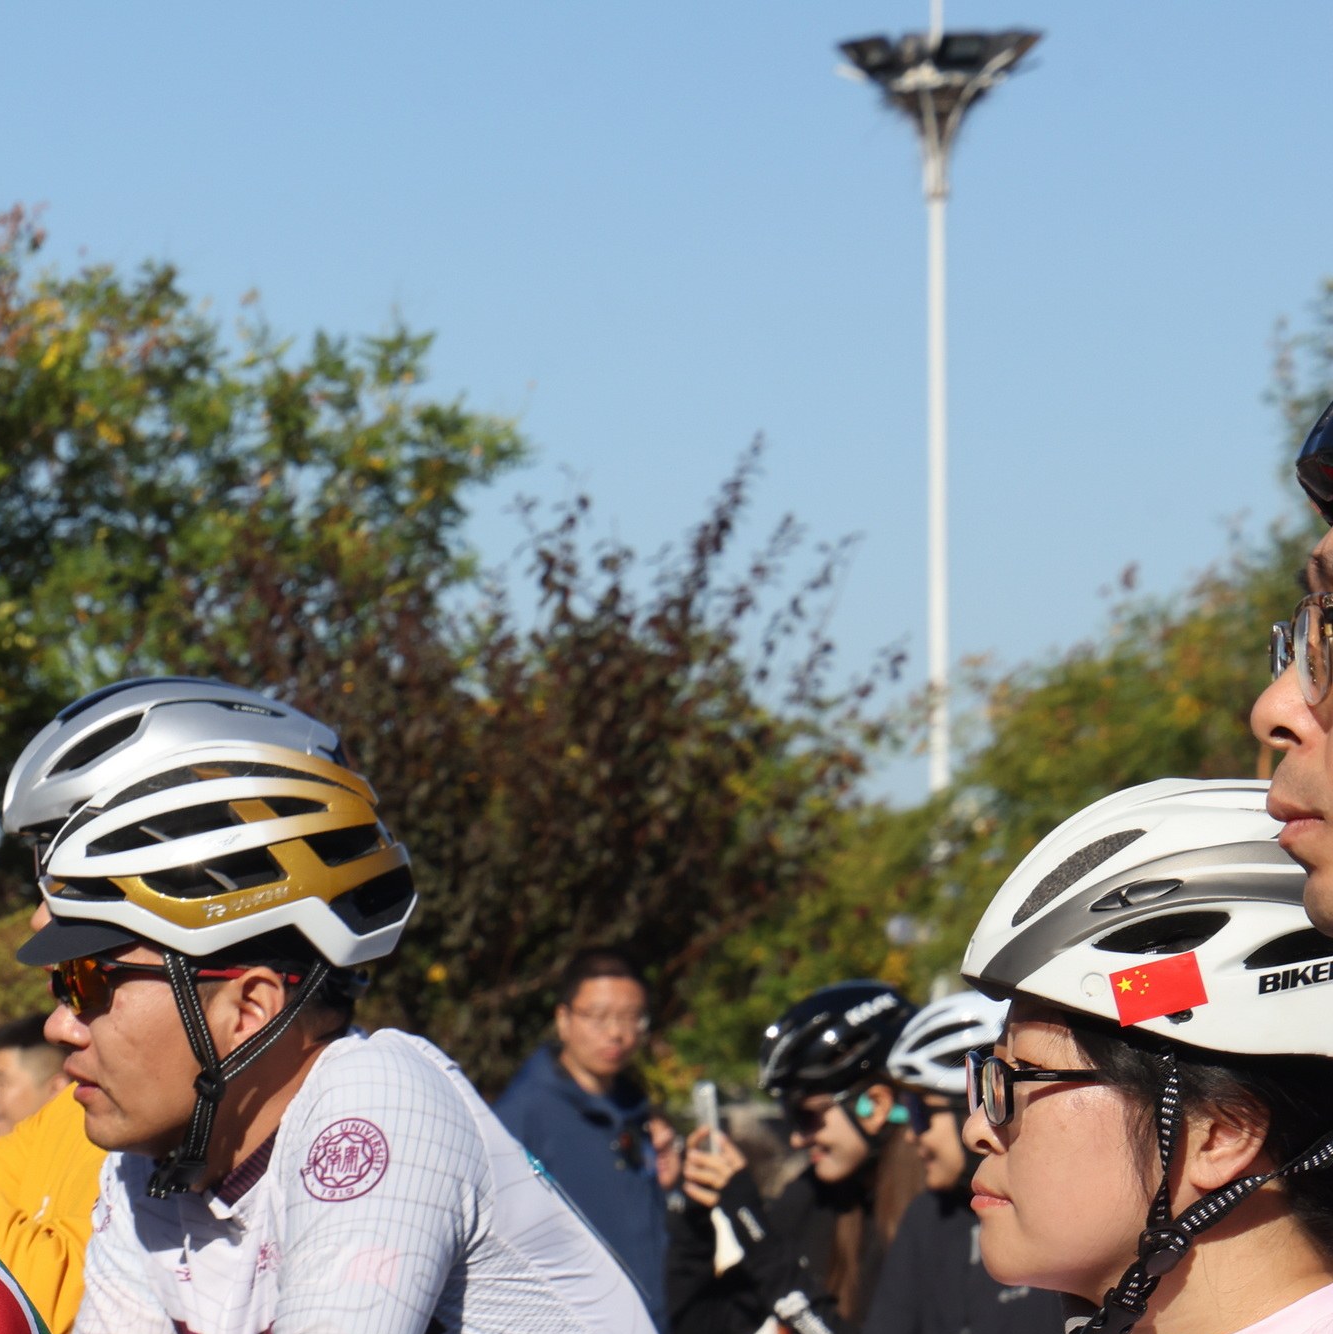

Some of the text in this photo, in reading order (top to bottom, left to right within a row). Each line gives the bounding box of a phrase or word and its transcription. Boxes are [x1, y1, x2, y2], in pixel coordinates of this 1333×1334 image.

[1258, 960, 1333, 995] BIKE
[339, 1122, 385, 1174] UNIVERSITY
[321, 1187, 355, 1199] 1919
